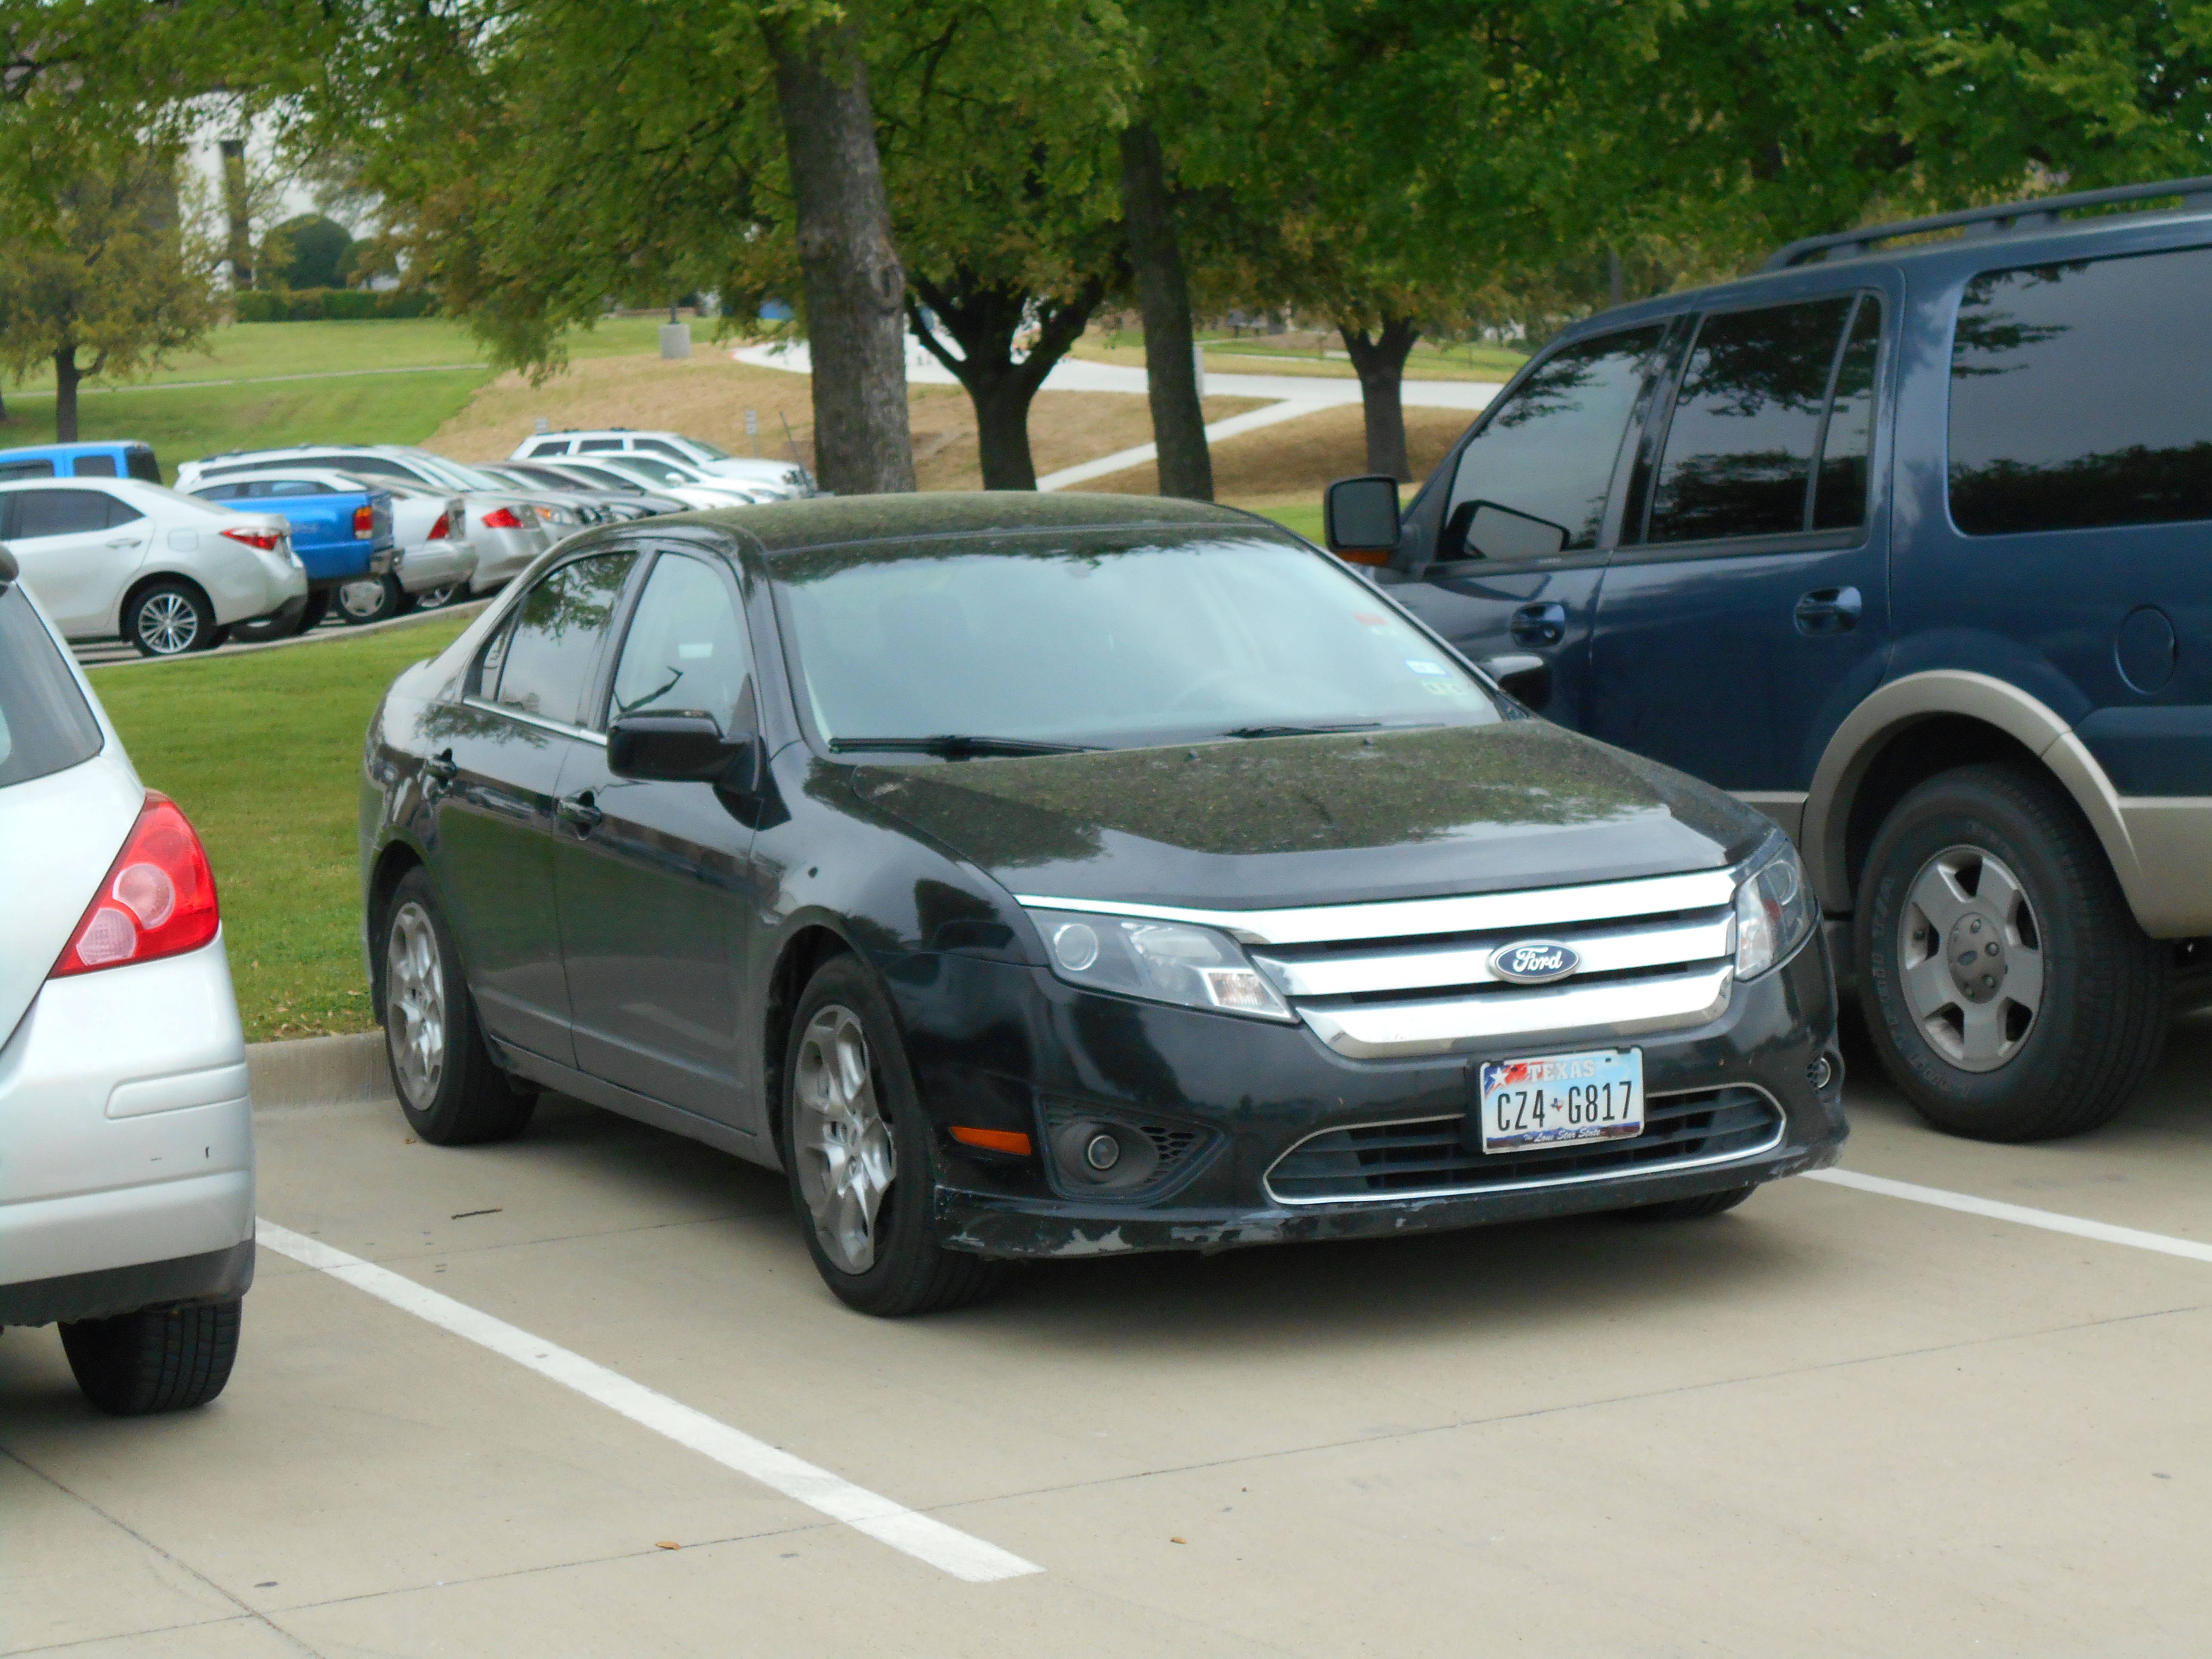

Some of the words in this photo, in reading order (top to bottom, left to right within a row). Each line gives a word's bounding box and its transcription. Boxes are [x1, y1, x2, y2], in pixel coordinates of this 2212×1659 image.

[1513, 947, 1563, 972] Ford
[1527, 1059, 1595, 1082] TEXAS
[1498, 1089, 1545, 1131] CZ4
[1568, 1081, 1632, 1124] G817
[1534, 1132, 1555, 1142] Lone
[1557, 1130, 1577, 1140] Star
[1578, 1127, 1601, 1137] State
